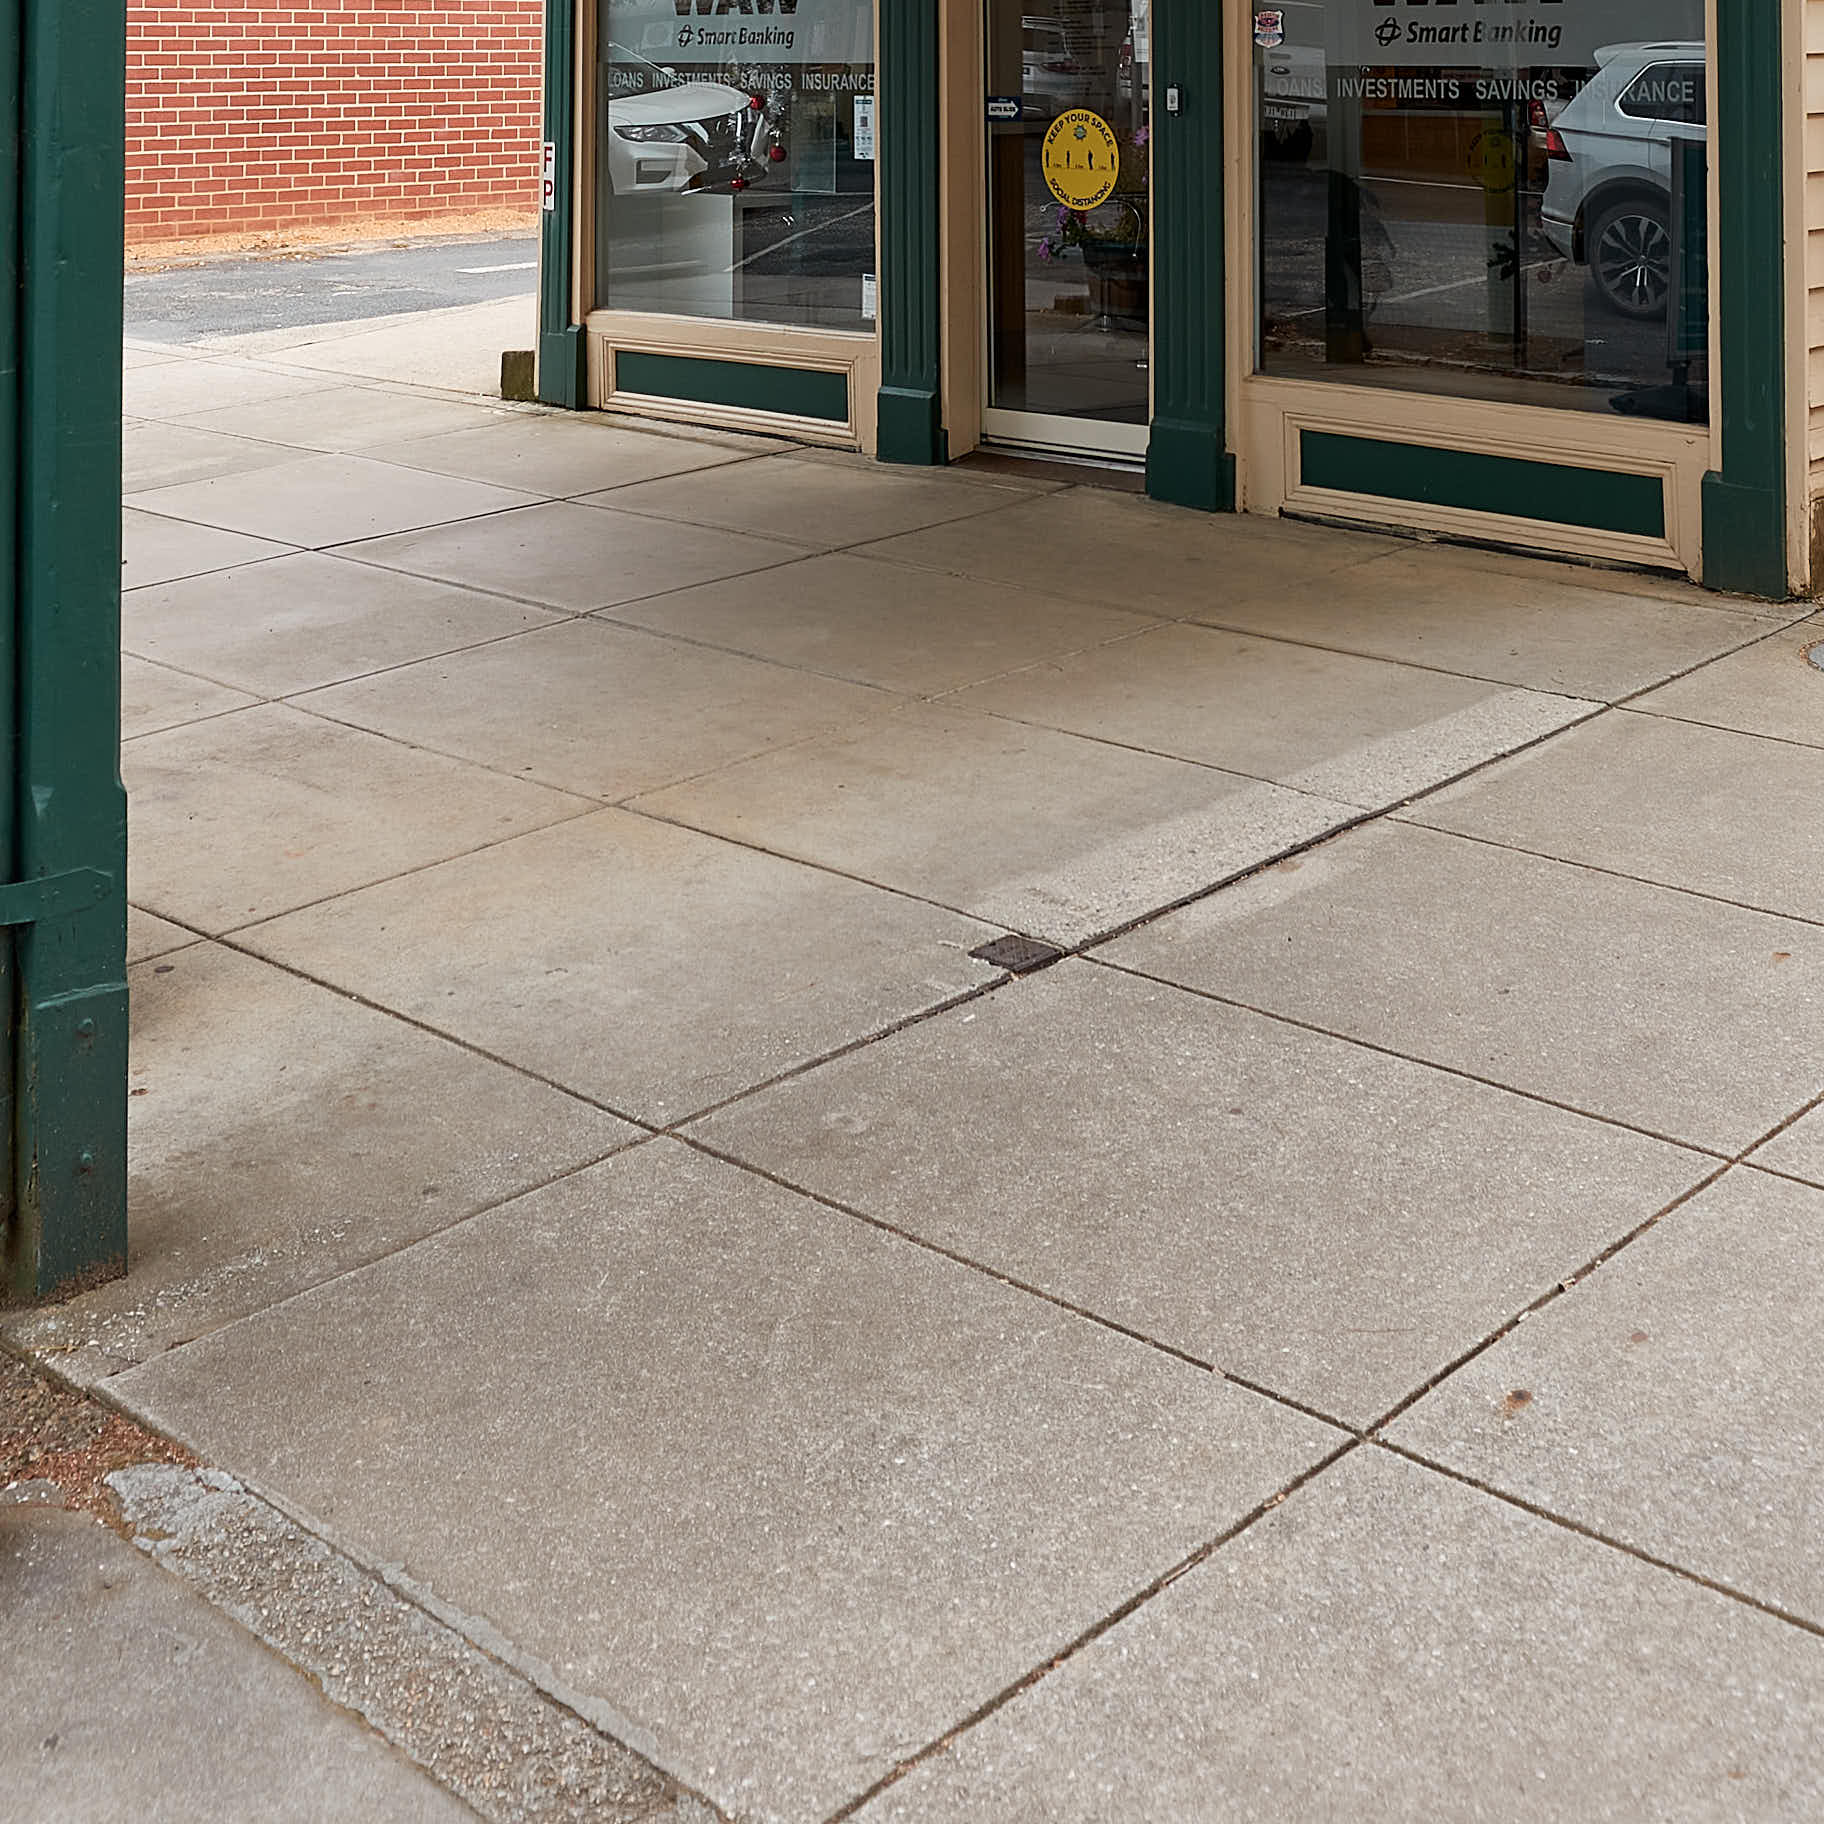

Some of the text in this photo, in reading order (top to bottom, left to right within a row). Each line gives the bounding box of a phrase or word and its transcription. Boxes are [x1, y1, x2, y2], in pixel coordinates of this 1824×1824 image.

[697, 26, 794, 49] Smart Banking
[1406, 19, 1562, 48] Smart Banking
[741, 72, 792, 89] SAVINGS
[801, 73, 874, 90] INSURANCE
[1266, 77, 1694, 103] OANS INVESTMENTS SAVINGS INRANCE
[1047, 114, 1113, 147] KEEP YOUR SPACE
[1050, 178, 1070, 203] SOCIAL
